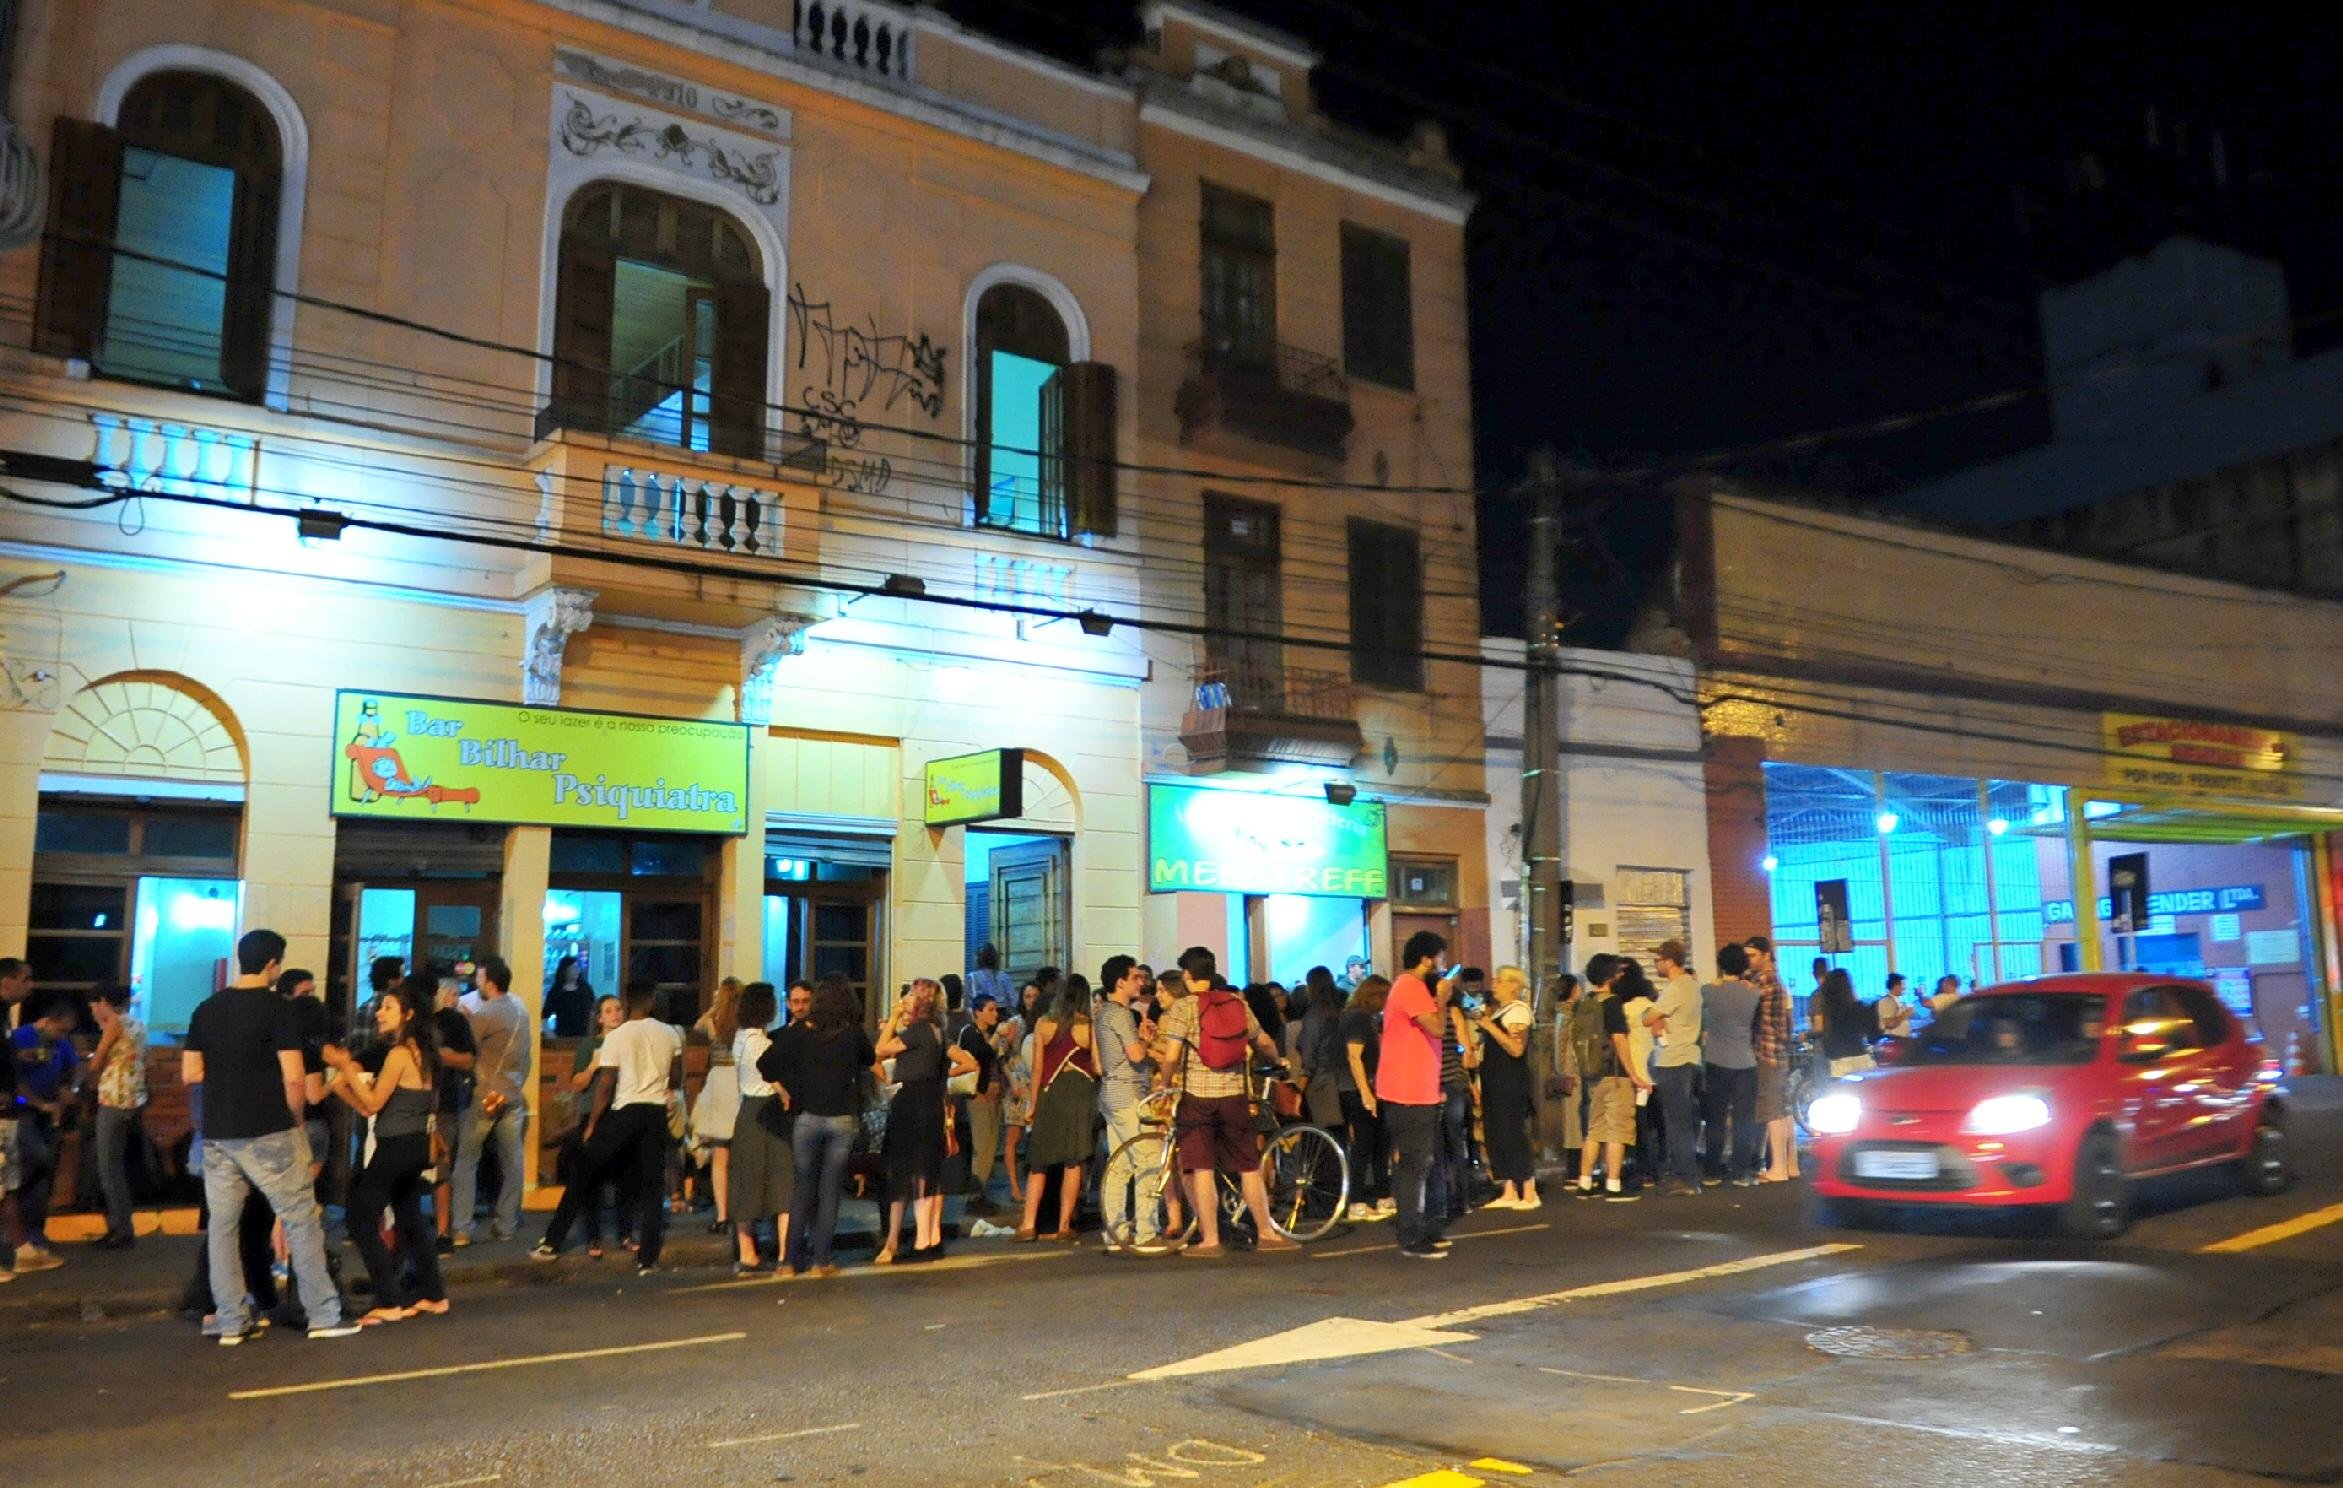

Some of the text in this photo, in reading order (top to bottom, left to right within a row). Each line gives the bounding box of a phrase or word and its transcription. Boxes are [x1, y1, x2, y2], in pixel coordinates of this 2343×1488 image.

[406, 710, 464, 738] Bar
[518, 711, 531, 723] O
[534, 714, 557, 726] seu
[560, 715, 590, 729] lazer
[607, 720, 617, 730] a
[620, 720, 655, 734] nossa
[658, 723, 744, 741] preocupação
[459, 738, 568, 772] Bilhar
[552, 773, 739, 821] Psiquiatra
